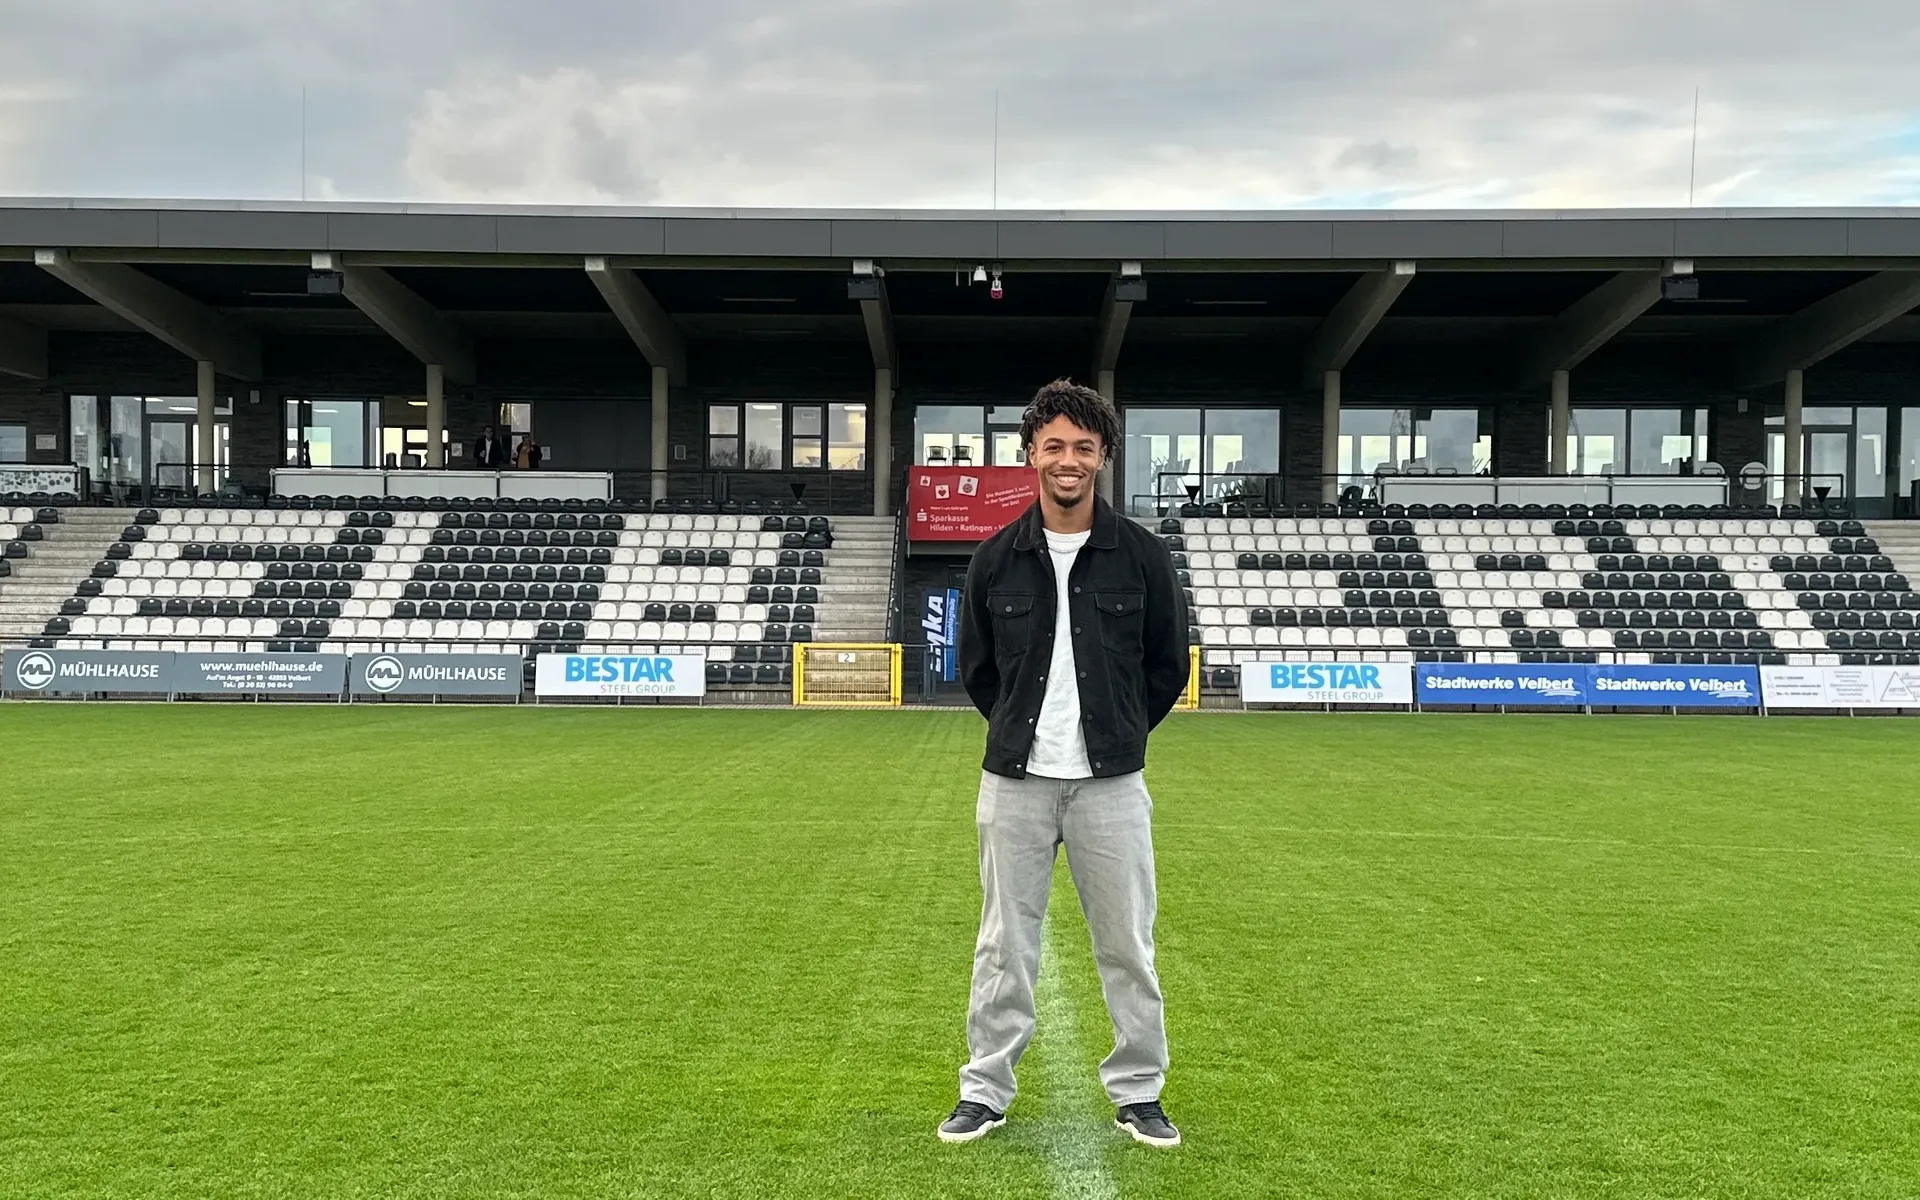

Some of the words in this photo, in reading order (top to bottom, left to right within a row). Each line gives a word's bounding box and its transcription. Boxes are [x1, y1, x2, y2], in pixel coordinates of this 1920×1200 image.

[930, 514, 969, 523] Sparkasse
[930, 524, 953, 532] Hilden
[960, 524, 993, 533] Ratingen
[844, 653, 849, 662] 2
[60, 661, 159, 678] MÜHLHAUSE
[200, 661, 323, 672] www.muehlhause.de
[408, 664, 506, 681] MÜHLHAUSE
[565, 656, 674, 682] BESTAR
[1270, 664, 1382, 689] BESTAR
[600, 684, 632, 694] STEEL
[636, 684, 676, 694] GROUP
[1426, 676, 1514, 690] Stadtwerke
[1517, 677, 1574, 691] Velbert
[1596, 677, 1685, 692] Stadtwerke
[1689, 678, 1747, 692] Velbert
[1308, 691, 1341, 700] STEEL
[1343, 692, 1383, 701] GROUP
